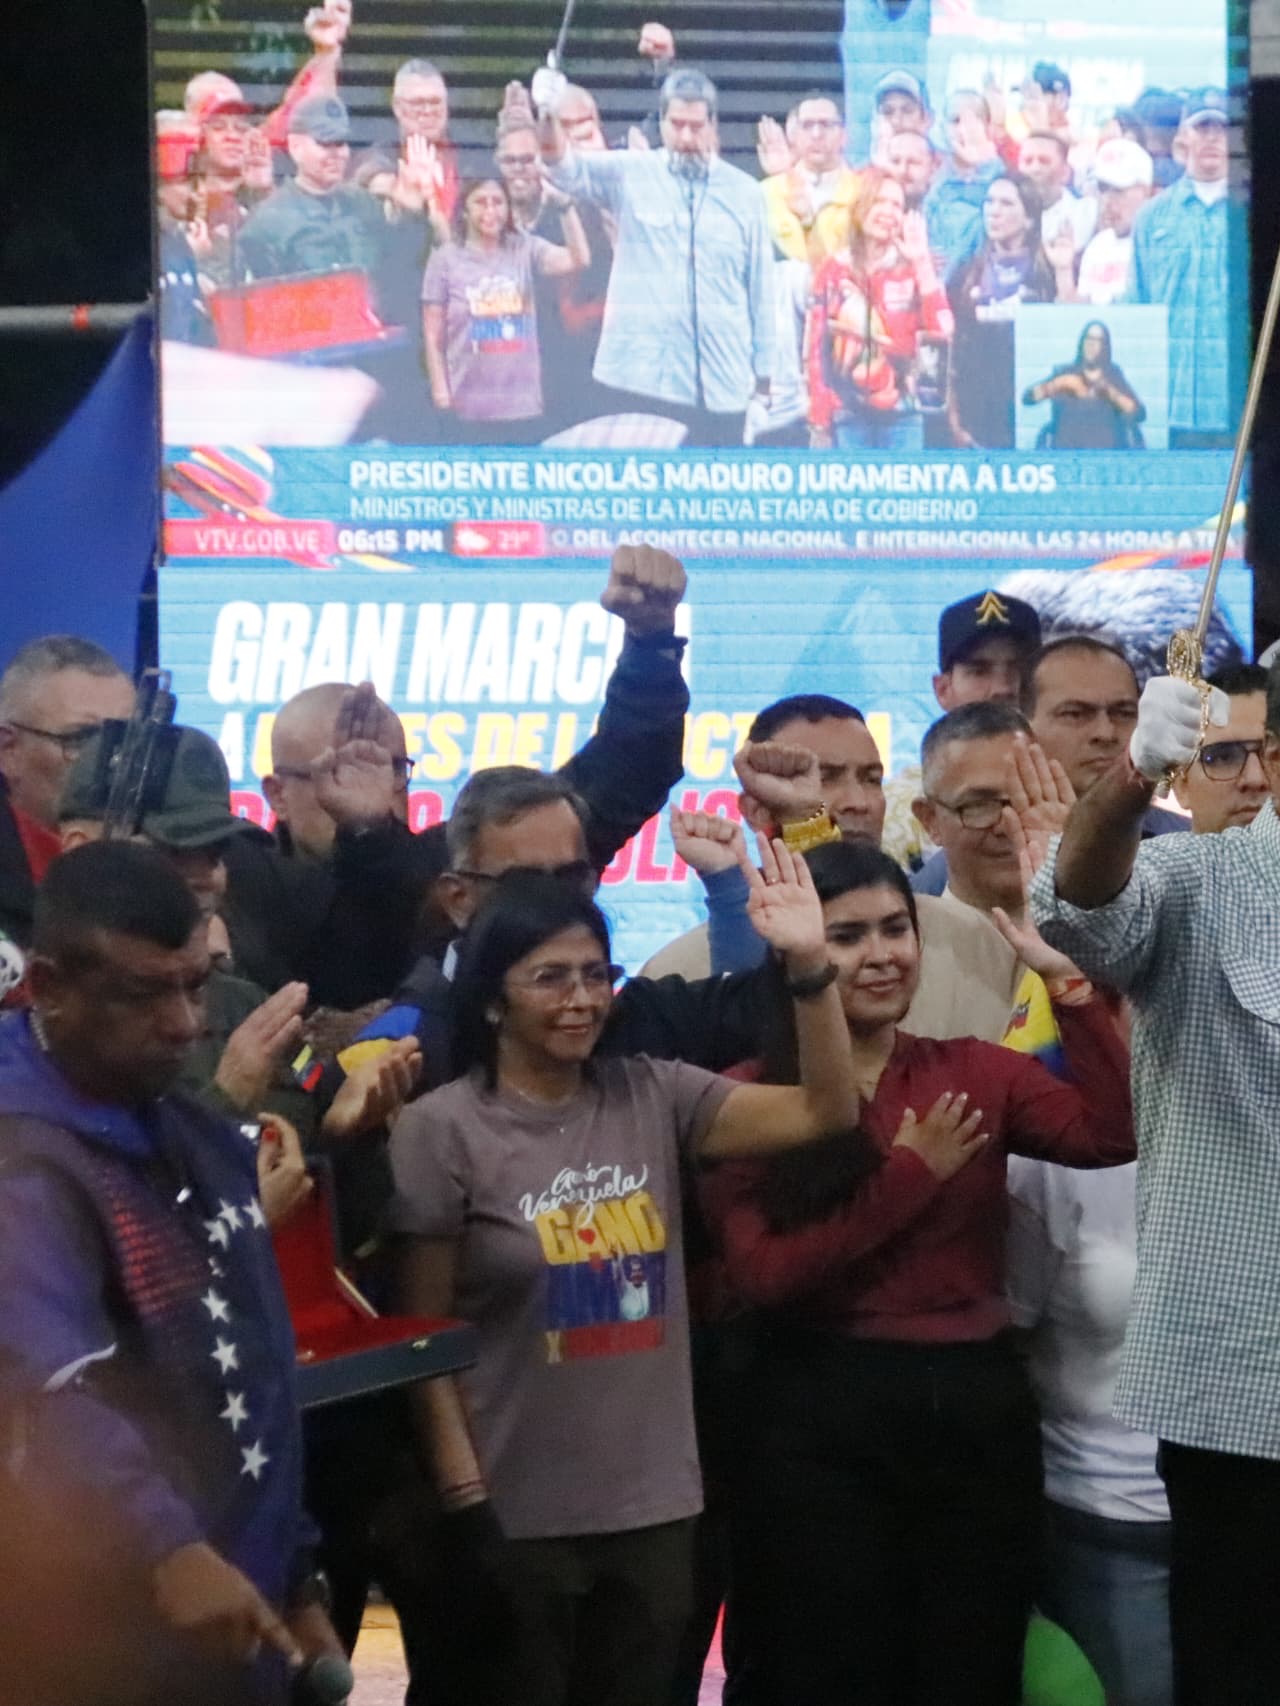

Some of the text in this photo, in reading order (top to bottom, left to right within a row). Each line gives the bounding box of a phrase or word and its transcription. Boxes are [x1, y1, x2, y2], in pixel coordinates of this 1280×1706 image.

[350, 457, 1056, 494] PRESIDENTE NICOLÁS MADURO JURAMENTA A LOS
[350, 497, 978, 521] MINISTROS Y MINISTRAS DE LA NUEVA ETAPA DE GOBIERNO
[194, 529, 319, 552] VTV.GOB.VE
[338, 529, 443, 551] 06:15 PM
[573, 529, 613, 547] DEL
[617, 530, 739, 547] ACONTECER
[742, 530, 846, 548] NACIONAL
[855, 531, 869, 548] E
[873, 531, 1033, 548] INTERNACIONAL
[1036, 531, 1072, 548] LAS
[1104, 530, 1174, 549] HORAS
[208, 601, 691, 700] GRAN MARC
